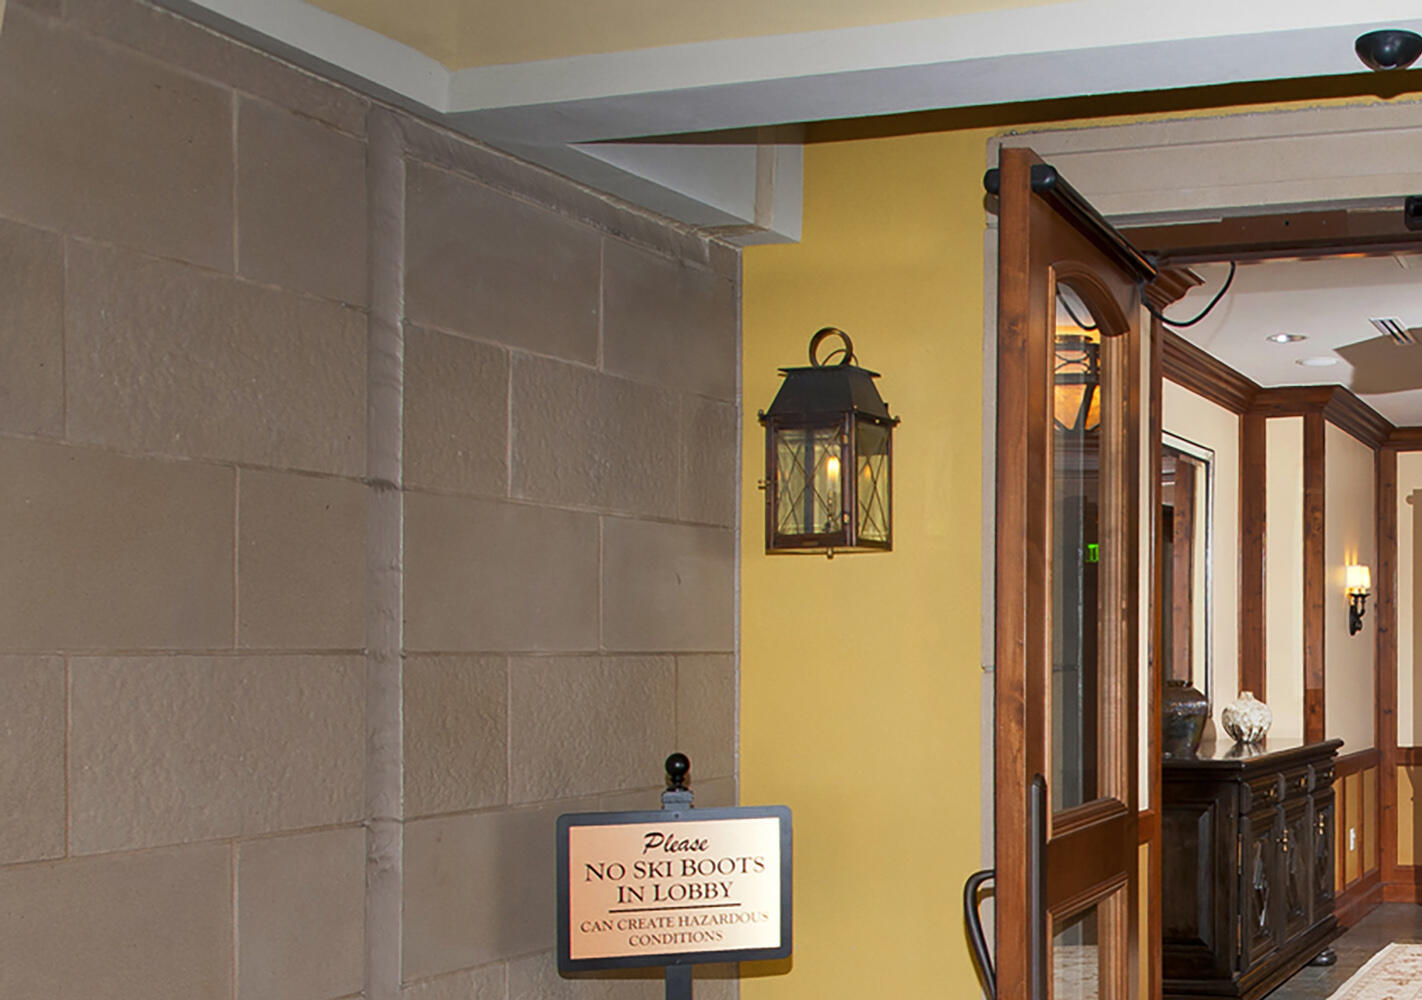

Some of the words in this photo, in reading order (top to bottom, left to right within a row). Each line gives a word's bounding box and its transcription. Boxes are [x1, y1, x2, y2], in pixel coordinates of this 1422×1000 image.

[643, 832, 709, 854] Please
[584, 862, 626, 882] NO
[633, 859, 674, 879] SKI
[681, 855, 766, 877] BOOTS
[617, 884, 645, 904] IN
[653, 881, 734, 901] LOBBY
[580, 919, 613, 933] CAN
[617, 915, 674, 931] CREATE
[679, 911, 769, 928] HAZARDOUS
[628, 930, 723, 947] CONDITIONS
